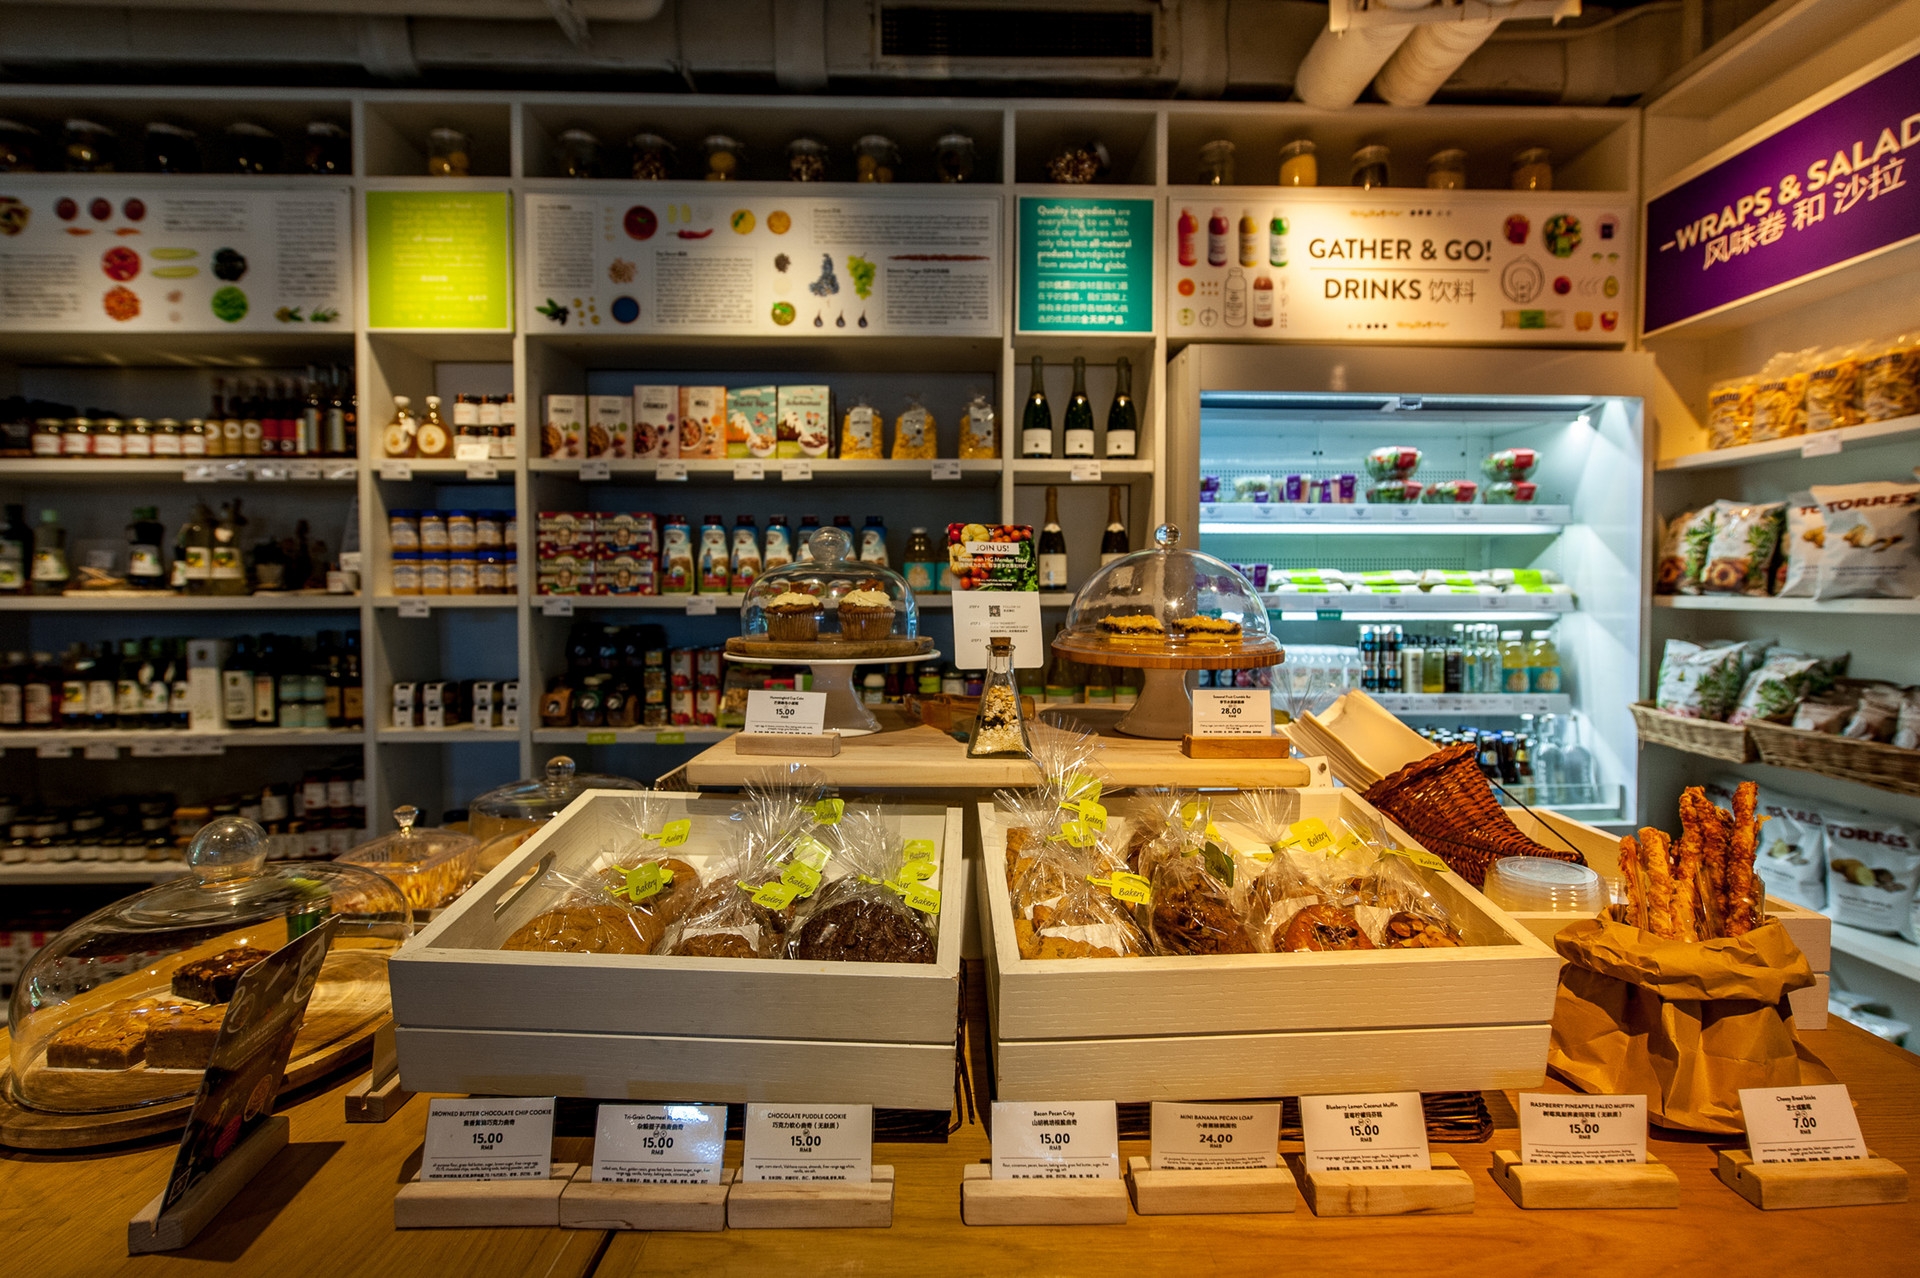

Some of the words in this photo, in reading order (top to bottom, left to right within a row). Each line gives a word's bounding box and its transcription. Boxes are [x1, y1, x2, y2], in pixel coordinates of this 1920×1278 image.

[1778, 175, 1801, 205] &
[1038, 205, 1068, 216] Quality
[1070, 206, 1116, 218] ingredients
[1703, 208, 1787, 270] 风味卷
[1792, 192, 1826, 231] 和
[1833, 157, 1907, 215] 沙拉
[1038, 218, 1085, 229] everything
[1087, 218, 1096, 226] to
[1114, 218, 1128, 226] We
[1038, 228, 1060, 236] stock
[1078, 228, 1109, 237] shelves
[1111, 229, 1129, 237] with
[1038, 239, 1054, 248] only
[1056, 238, 1070, 247] the
[1071, 238, 1088, 247] best
[1089, 238, 1132, 248] all-natural
[1038, 249, 1073, 260] products
[1075, 250, 1126, 260] handpicked
[1309, 238, 1412, 260] GATHER
[1420, 240, 1437, 260] &
[1445, 240, 1492, 262] GO!
[1038, 260, 1057, 268] from
[1059, 260, 1088, 269] around
[1089, 260, 1103, 269] the
[1104, 261, 1128, 272] globe.
[1325, 279, 1422, 300] DRINKS
[1429, 278, 1476, 304] 饮料
[1827, 492, 1917, 513] TORRES
[976, 544, 994, 552] JOIN
[1084, 814, 1104, 830] Bakery
[665, 833, 684, 844] Bakery
[1308, 831, 1330, 848] Bakery
[909, 850, 931, 861] Bakery
[1419, 858, 1445, 869] Bakery
[635, 878, 658, 896] Bakery
[787, 876, 812, 893] Bakery
[1119, 888, 1145, 901] Bakery
[759, 894, 785, 907] Bakery
[912, 896, 938, 910] Bakery
[1793, 1117, 1817, 1128] 7.00
[1350, 1125, 1379, 1136] 15.00
[1569, 1124, 1600, 1134] 15.00
[472, 1133, 503, 1143] 15.00
[643, 1137, 674, 1148] 15.00
[791, 1136, 821, 1146] 15.00
[1040, 1133, 1070, 1144] 15.00
[1199, 1134, 1233, 1143] 24.00
